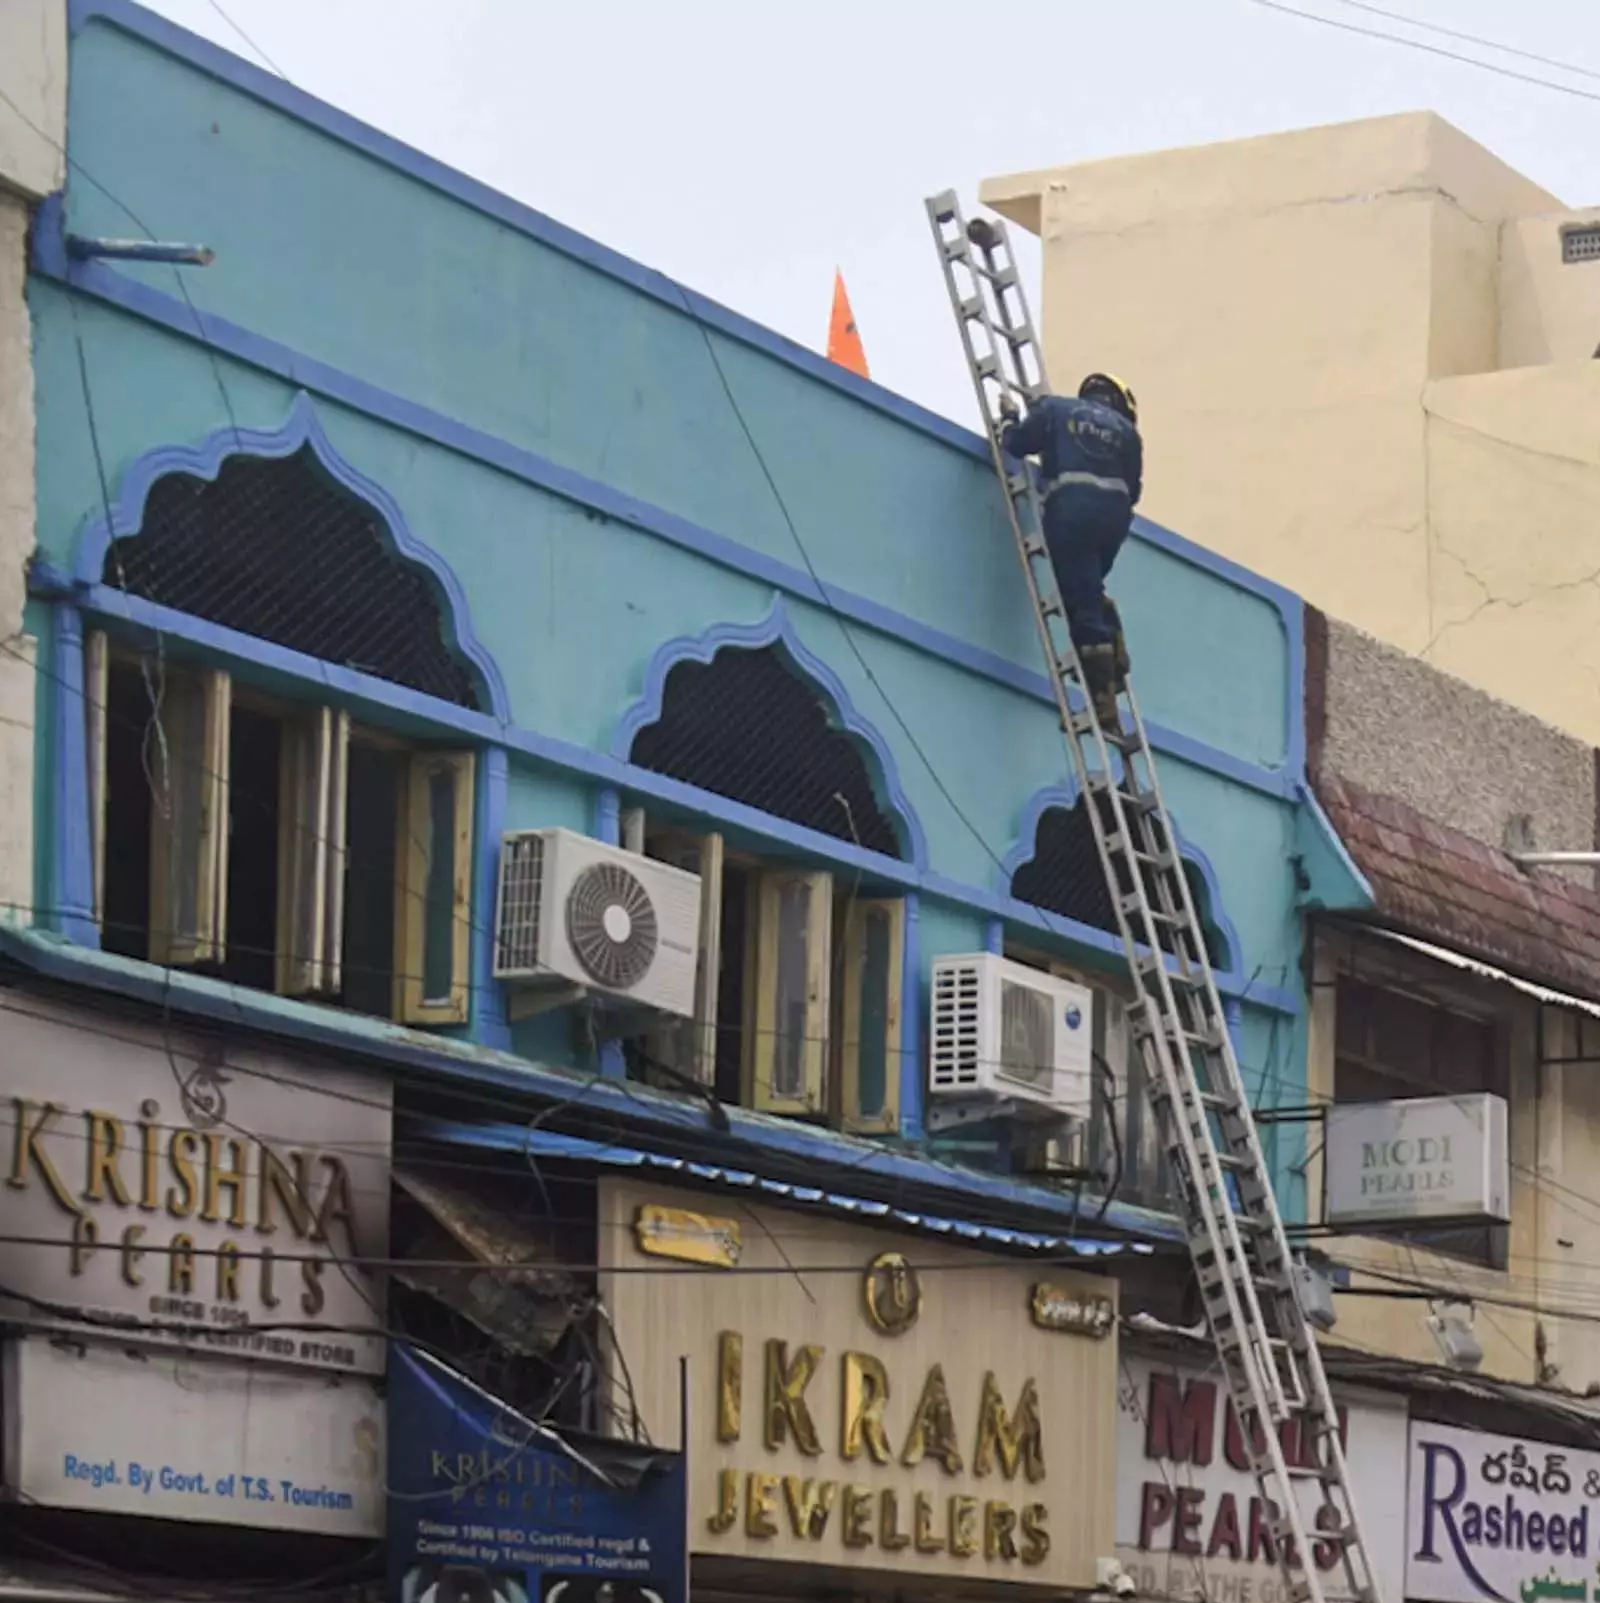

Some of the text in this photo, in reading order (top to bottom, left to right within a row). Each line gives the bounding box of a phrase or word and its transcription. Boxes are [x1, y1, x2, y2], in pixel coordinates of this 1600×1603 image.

[70, 1213, 324, 1317] PEARLS
[299, 1340, 356, 1366] STORE
[716, 1329, 1046, 1484] IKRAM
[64, 1453, 354, 1510] Regd. By Govt. of T.S. Tourism
[706, 1465, 1051, 1566] JEWELLERS
[588, 1552, 650, 1571] Tourism
